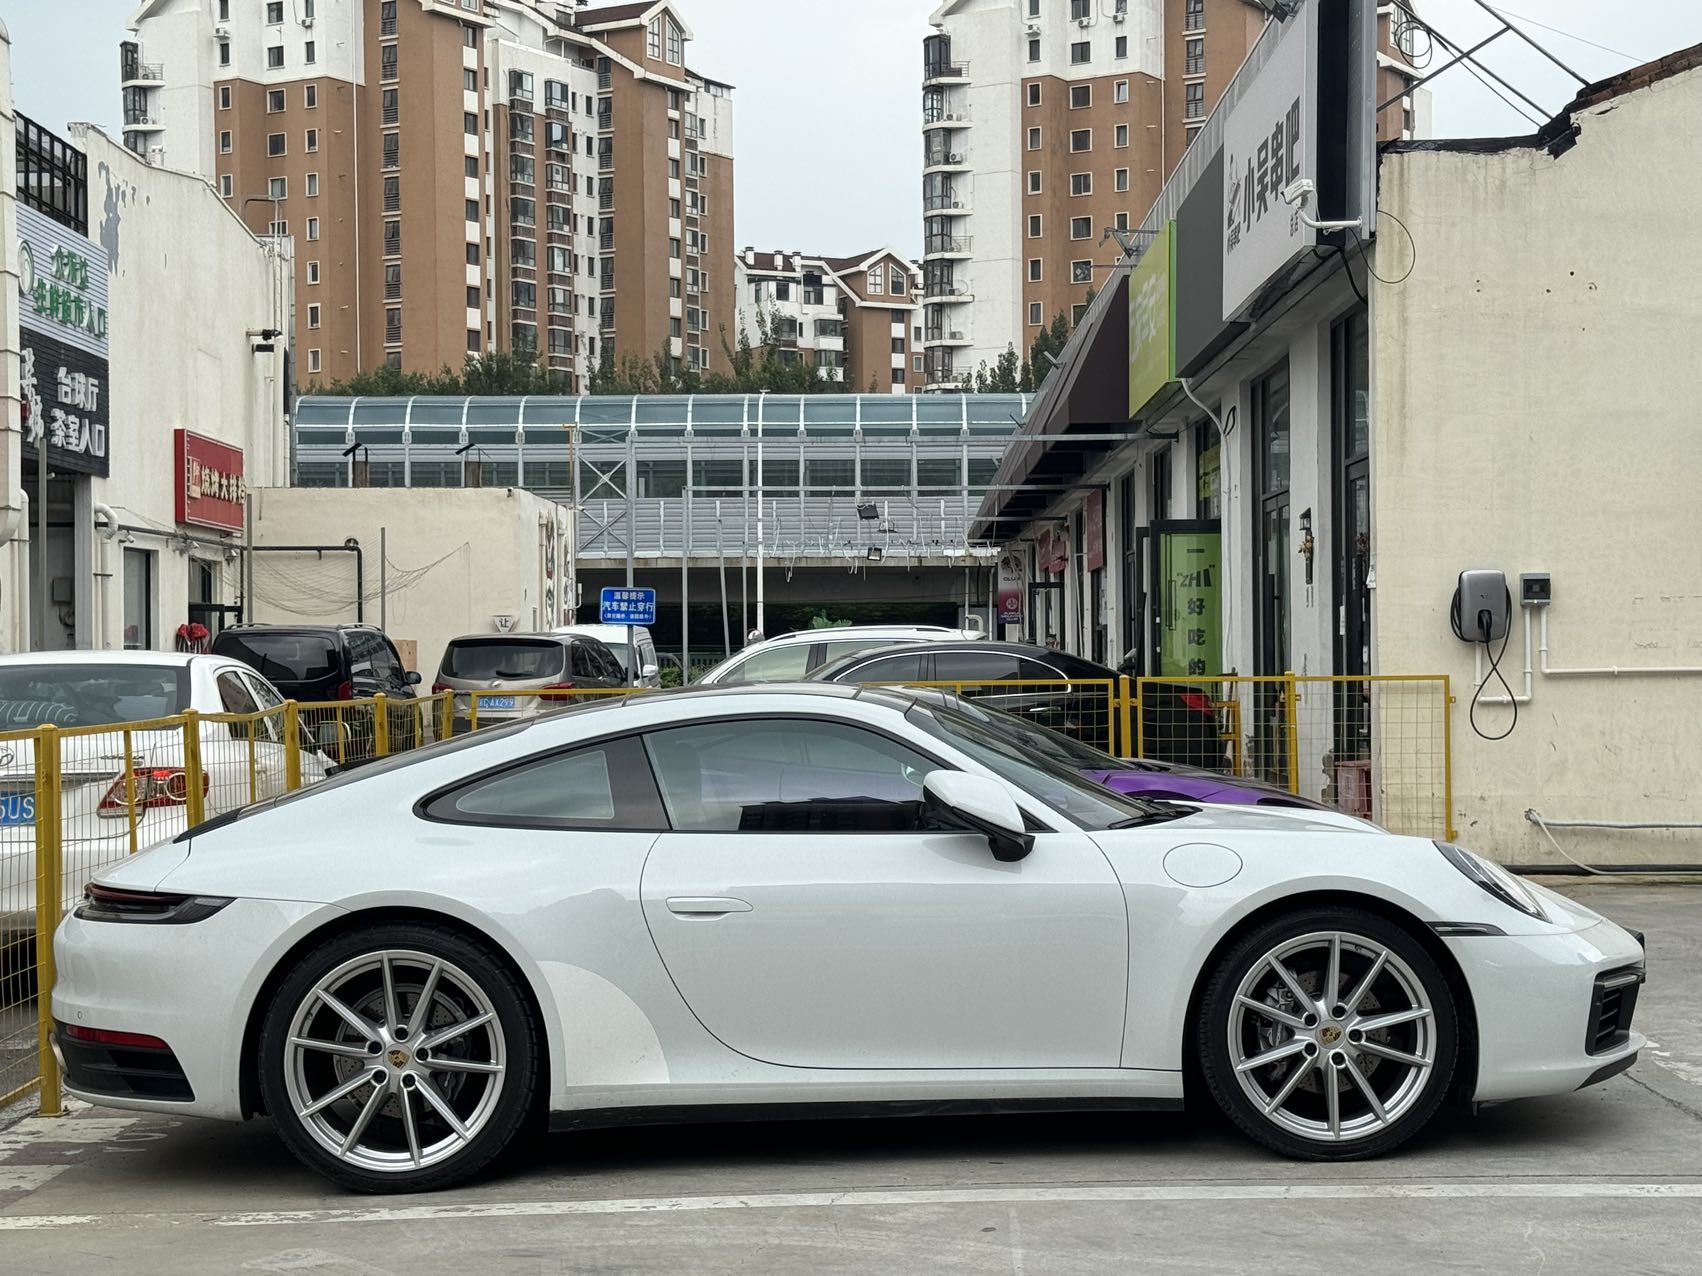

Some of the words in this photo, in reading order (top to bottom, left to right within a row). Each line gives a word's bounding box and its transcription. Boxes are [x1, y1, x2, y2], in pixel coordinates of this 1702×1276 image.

[1243, 95, 1300, 233] 小吴串吧
[57, 366, 99, 412] 台球厅
[50, 408, 106, 458] 茶室入口
[499, 617, 509, 629] 让
[602, 601, 654, 612] 汽车禁止穿行
